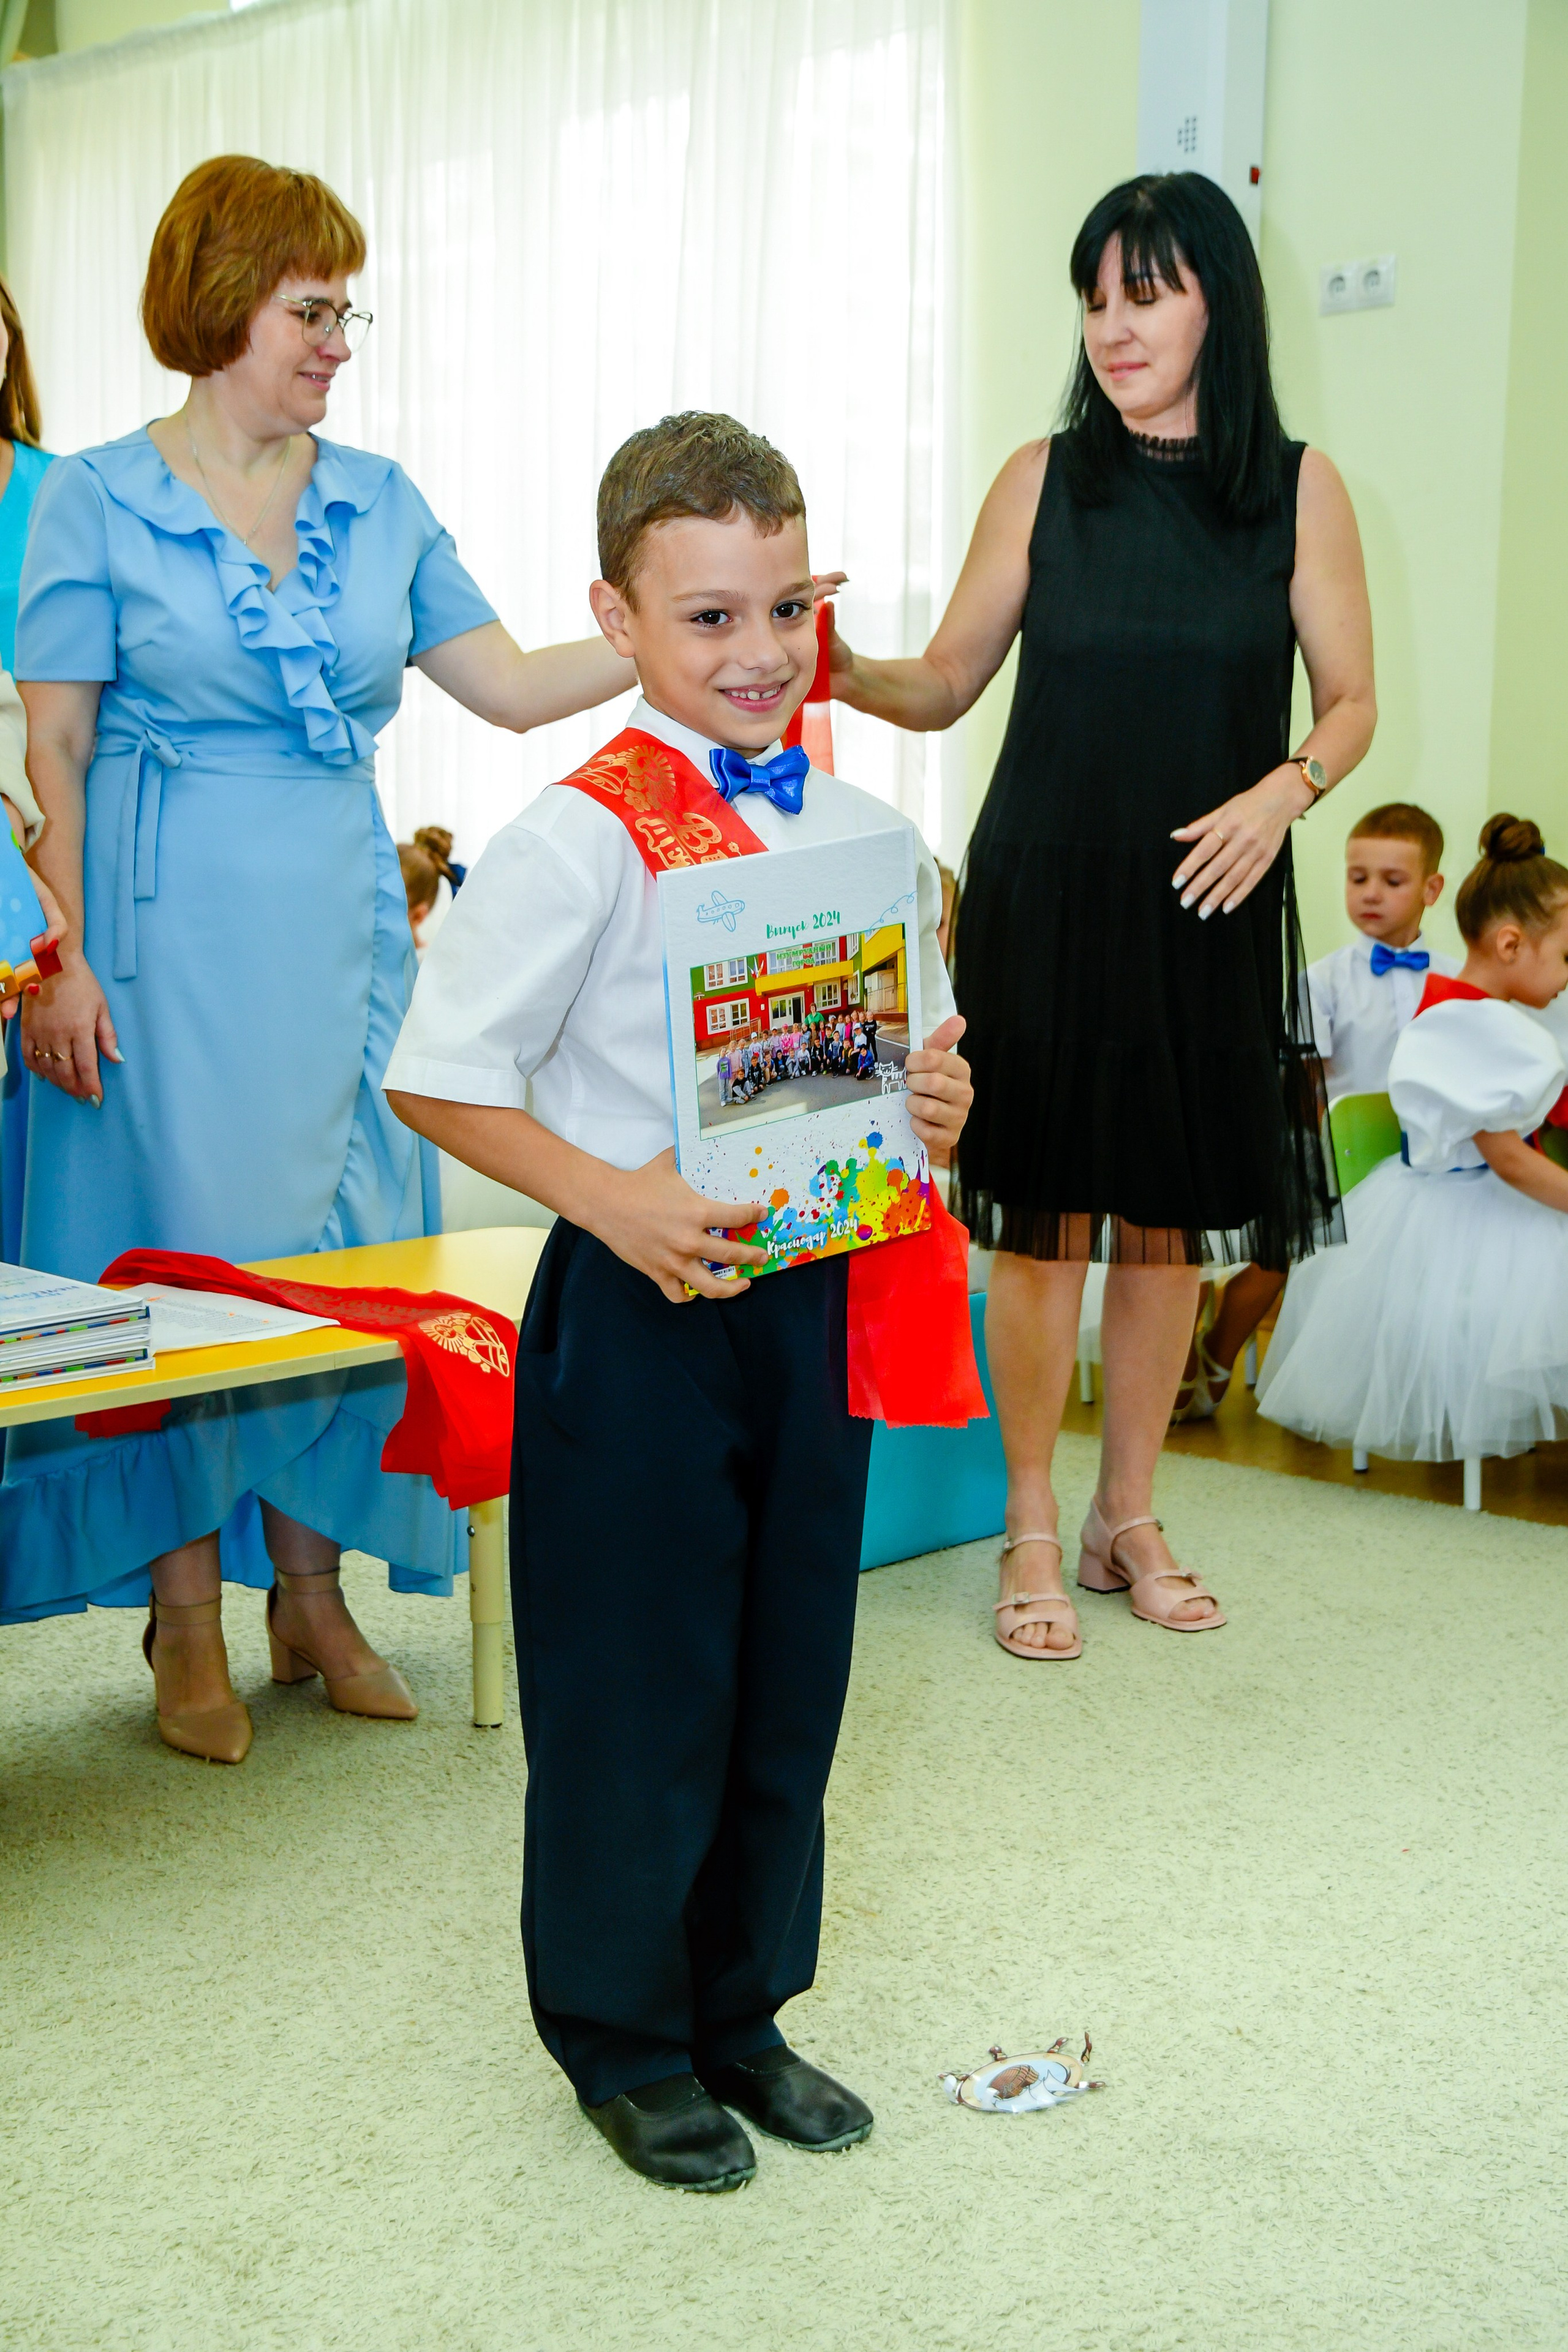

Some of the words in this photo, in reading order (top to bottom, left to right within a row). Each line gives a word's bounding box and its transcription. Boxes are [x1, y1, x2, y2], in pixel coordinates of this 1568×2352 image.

[813, 910, 840, 929] 2024
[792, 958, 815, 967] ГОРОД
[767, 1231, 826, 1259] Краснодар
[830, 1219, 858, 1238] 2024
